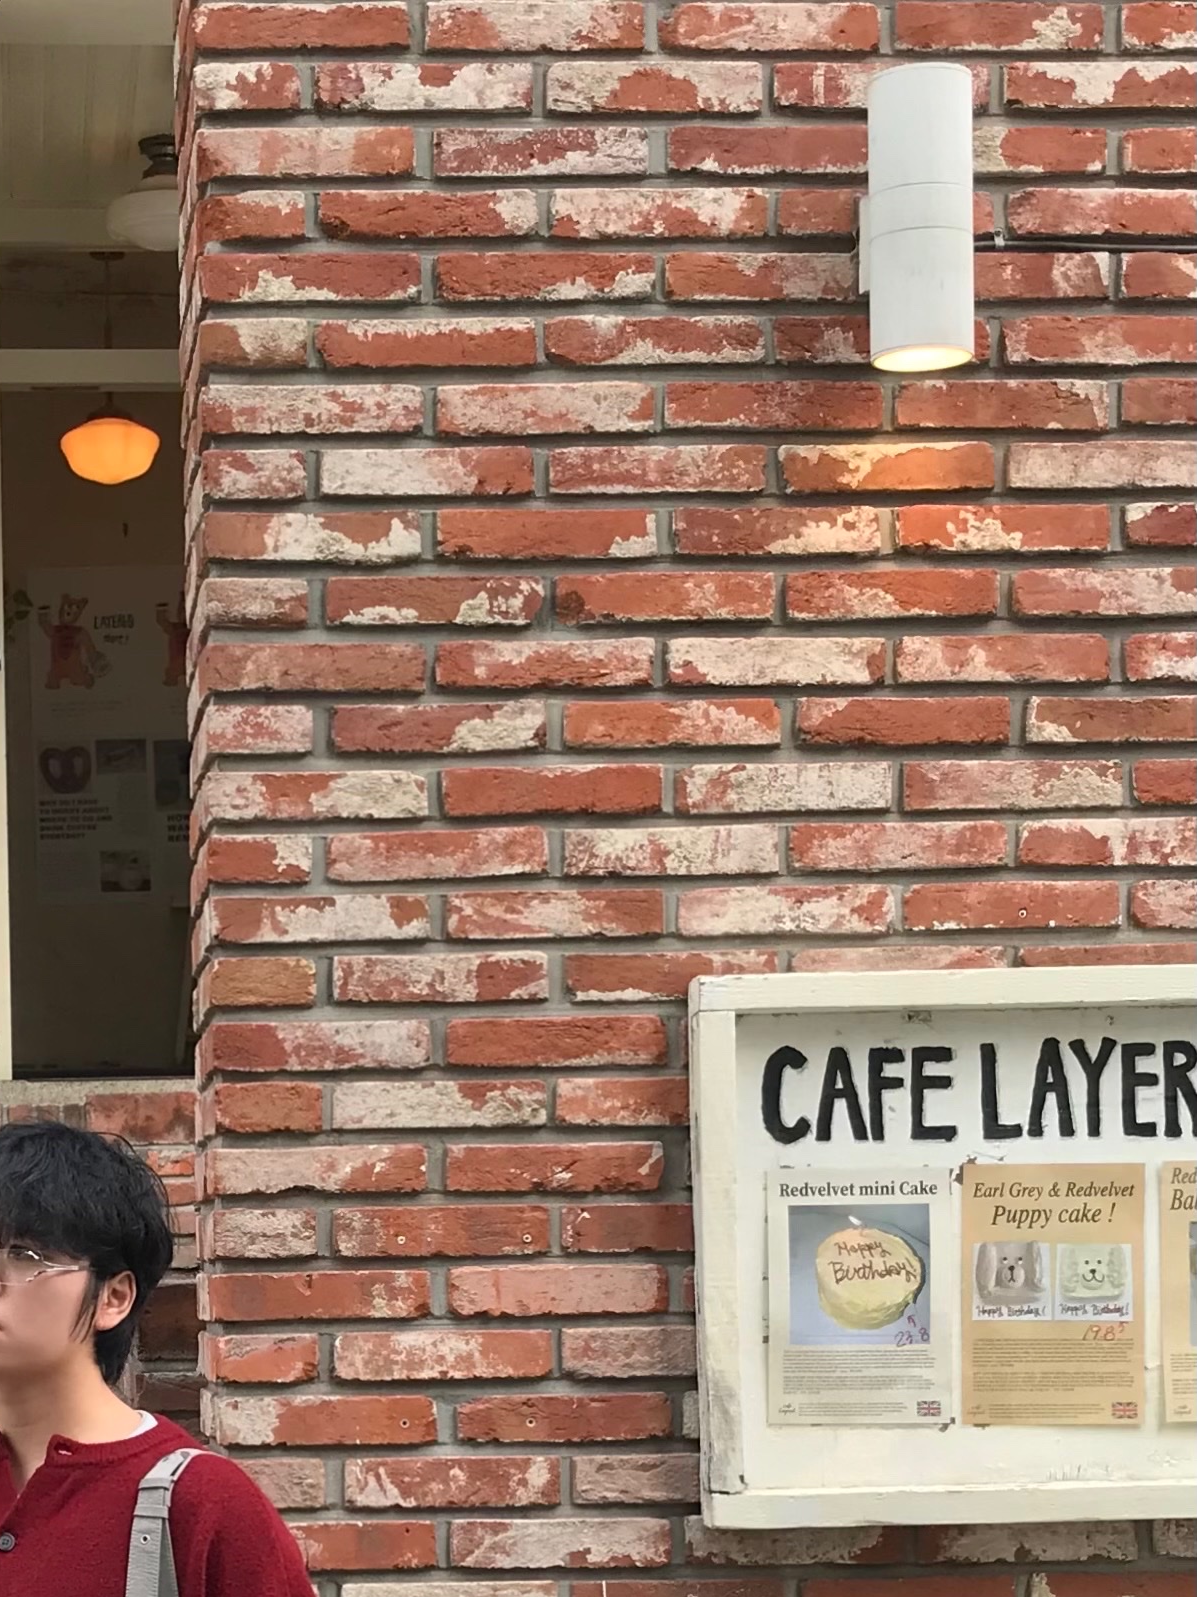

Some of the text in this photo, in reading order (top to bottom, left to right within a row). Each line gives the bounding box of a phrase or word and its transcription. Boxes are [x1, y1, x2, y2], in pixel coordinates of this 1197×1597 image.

[761, 1037, 1197, 1145] CAFE LAYER
[779, 1180, 938, 1197] Redvelvet mini Cake
[973, 1181, 1135, 1201] Earl Grey & Redvelvet
[991, 1205, 1053, 1229] Puppy
[1058, 1202, 1102, 1223] cake
[834, 1241, 892, 1259] Happy
[828, 1257, 917, 1285] Birthday!
